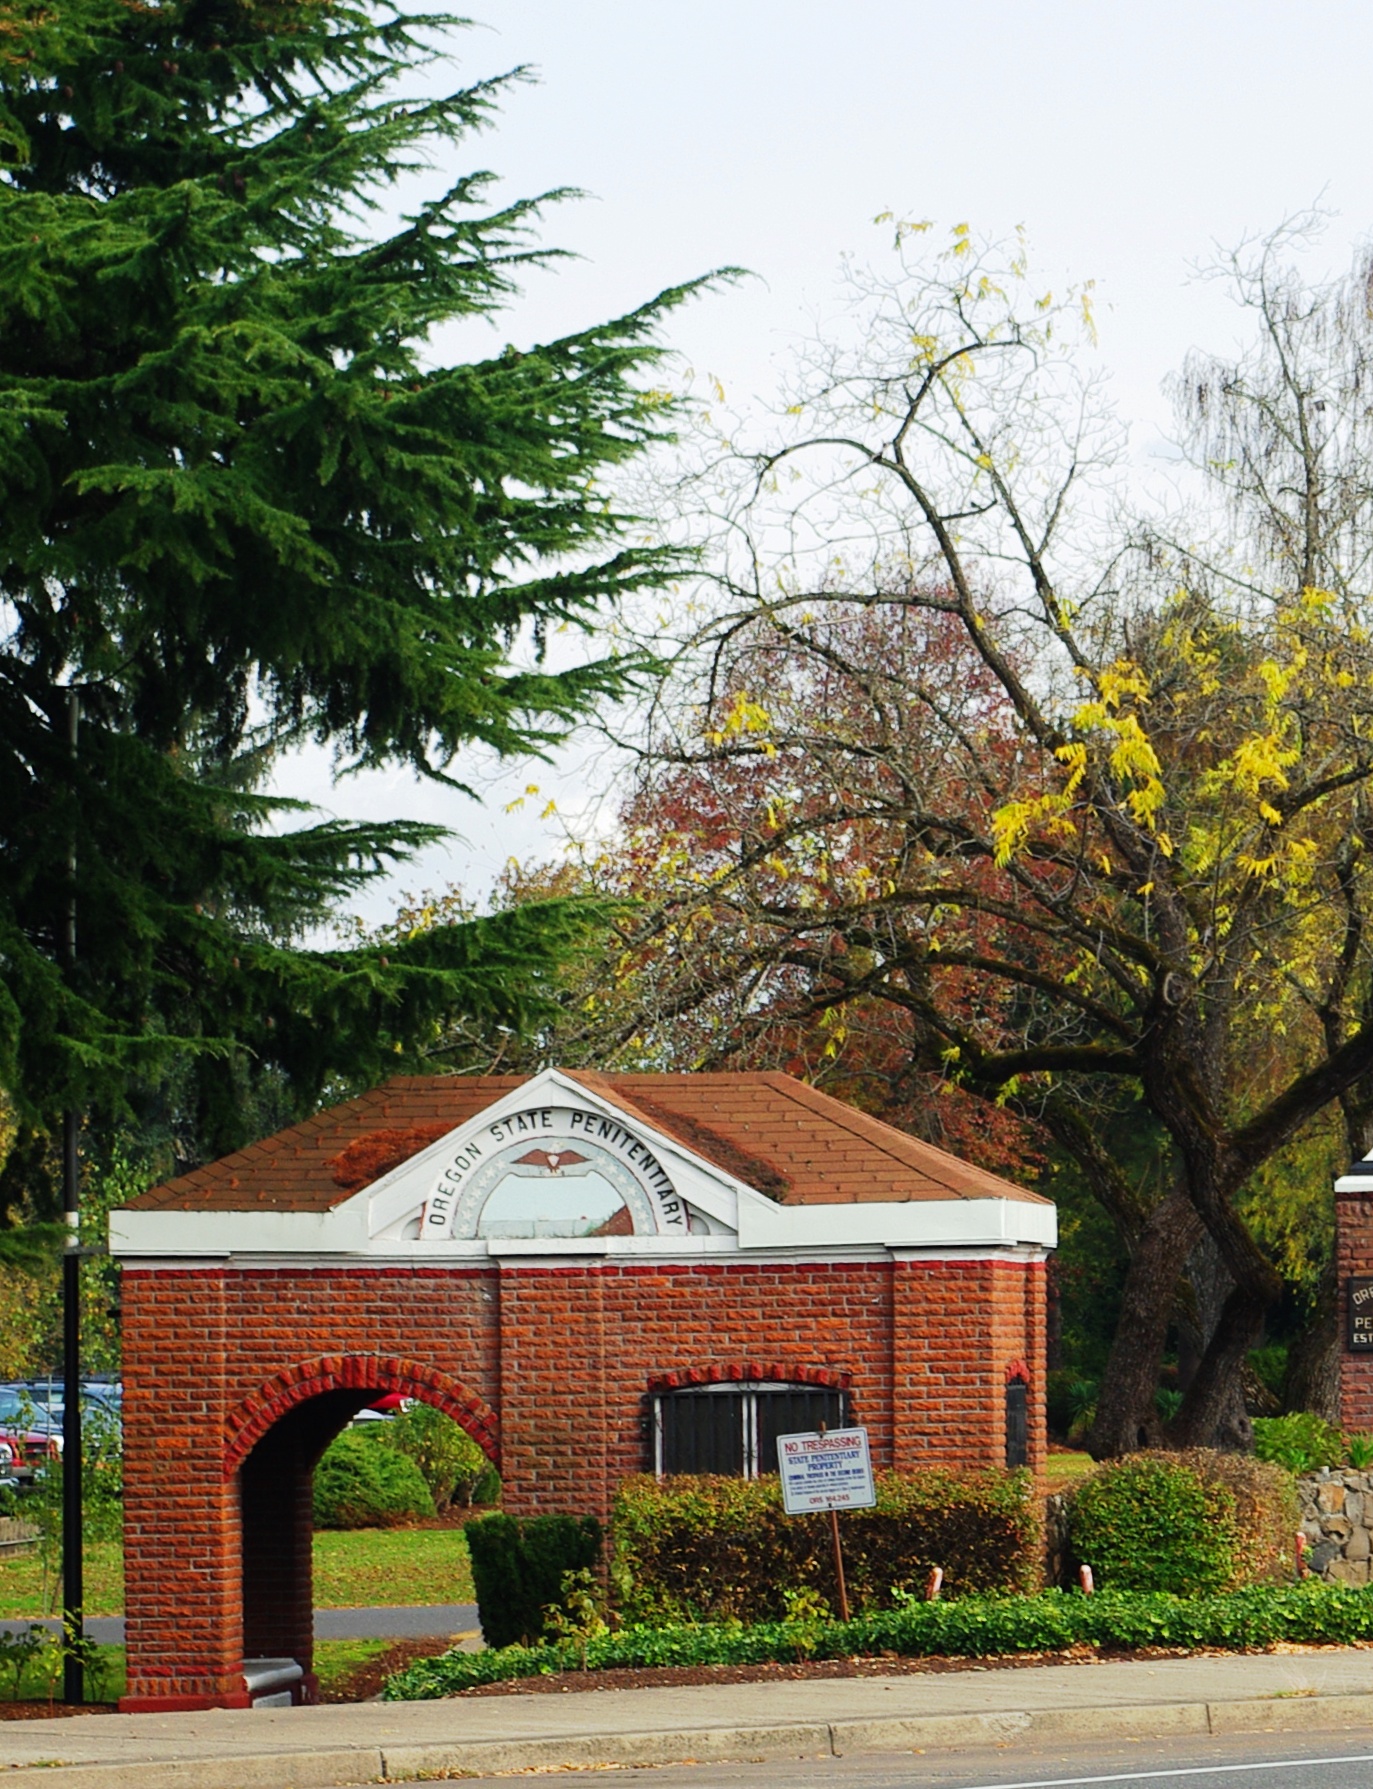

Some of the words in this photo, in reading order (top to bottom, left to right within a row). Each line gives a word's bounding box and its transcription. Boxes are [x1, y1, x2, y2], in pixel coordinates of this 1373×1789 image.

[430, 1142, 482, 1226] OREGON
[490, 1110, 553, 1142] STATE
[570, 1112, 682, 1226] PENITENTIARY
[785, 1442, 798, 1452] NO
[802, 1436, 861, 1450] TRESPASSING
[788, 1456, 809, 1464] STATE
[812, 1450, 860, 1462] PENITENTIARY
[808, 1461, 842, 1471] PROPERTY
